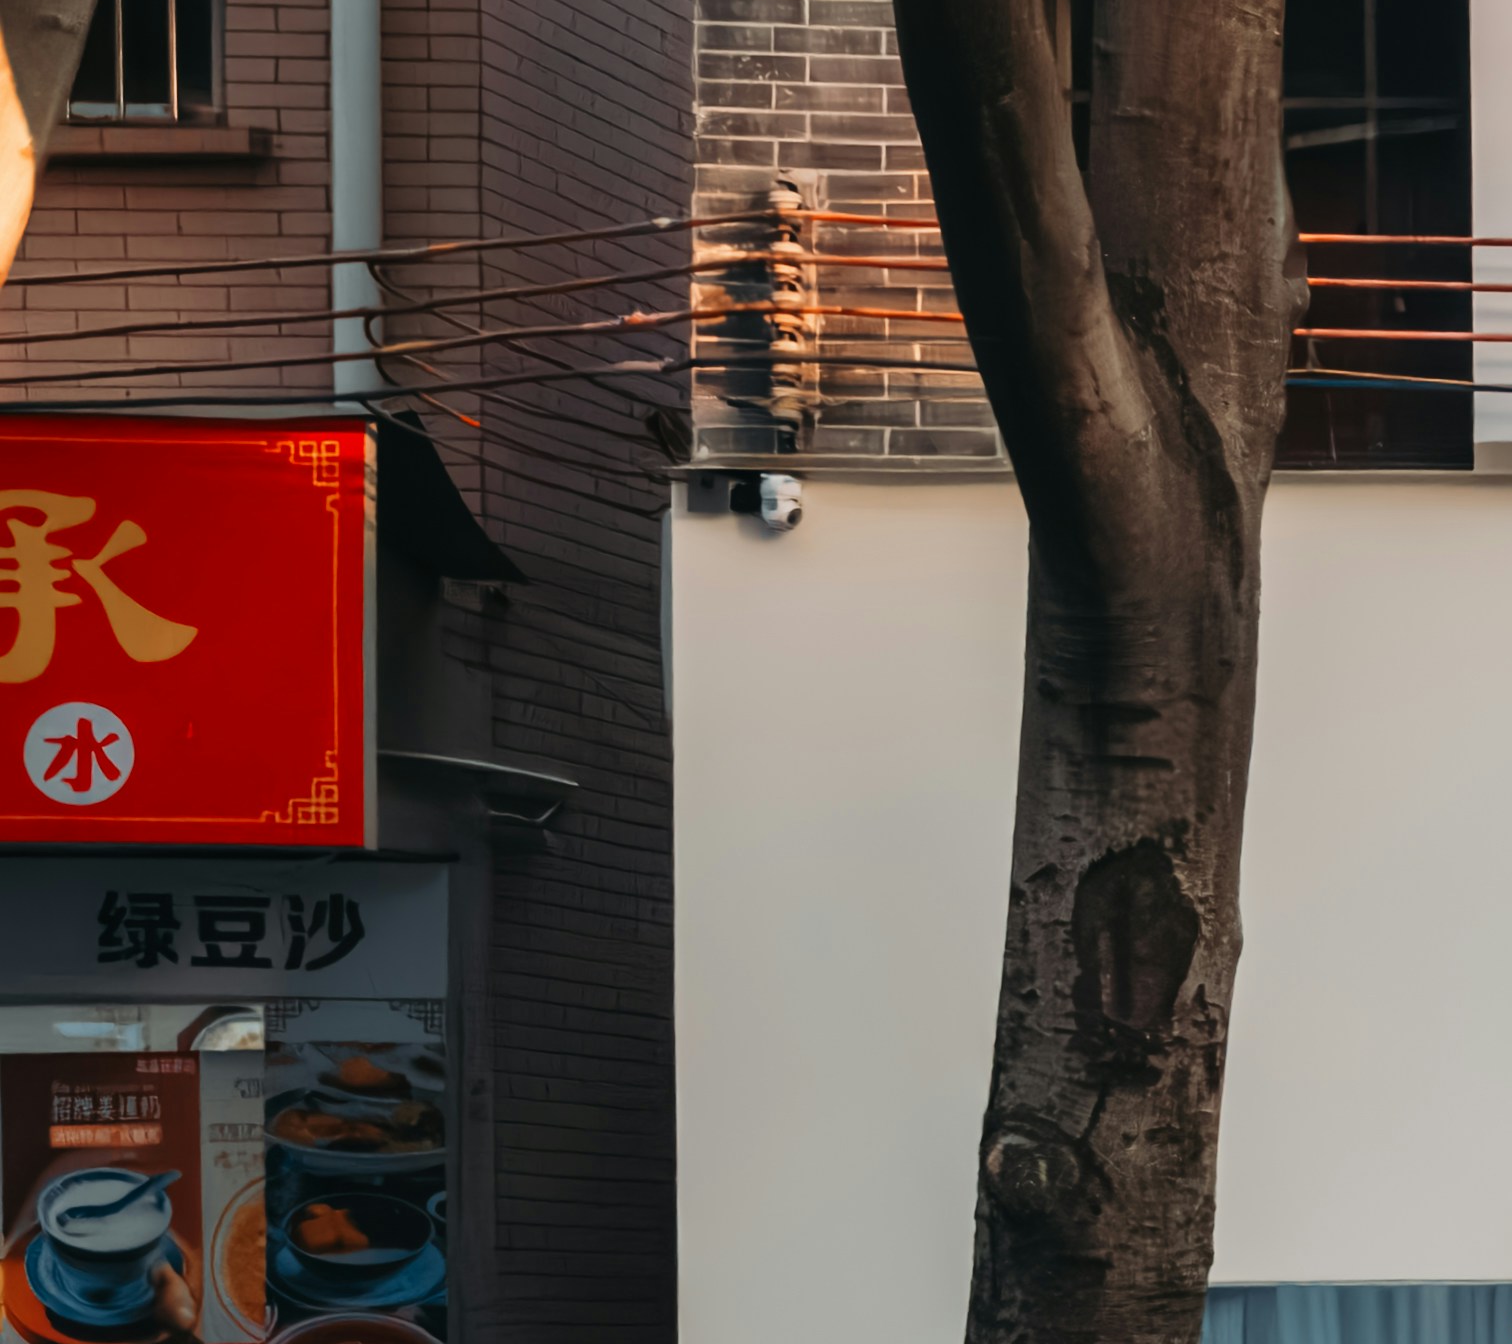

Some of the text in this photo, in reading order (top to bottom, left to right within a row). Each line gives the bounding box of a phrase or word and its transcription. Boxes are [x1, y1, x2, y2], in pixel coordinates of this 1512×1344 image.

[43, 718, 121, 793] 水
[97, 890, 365, 972] 绿豆沙
